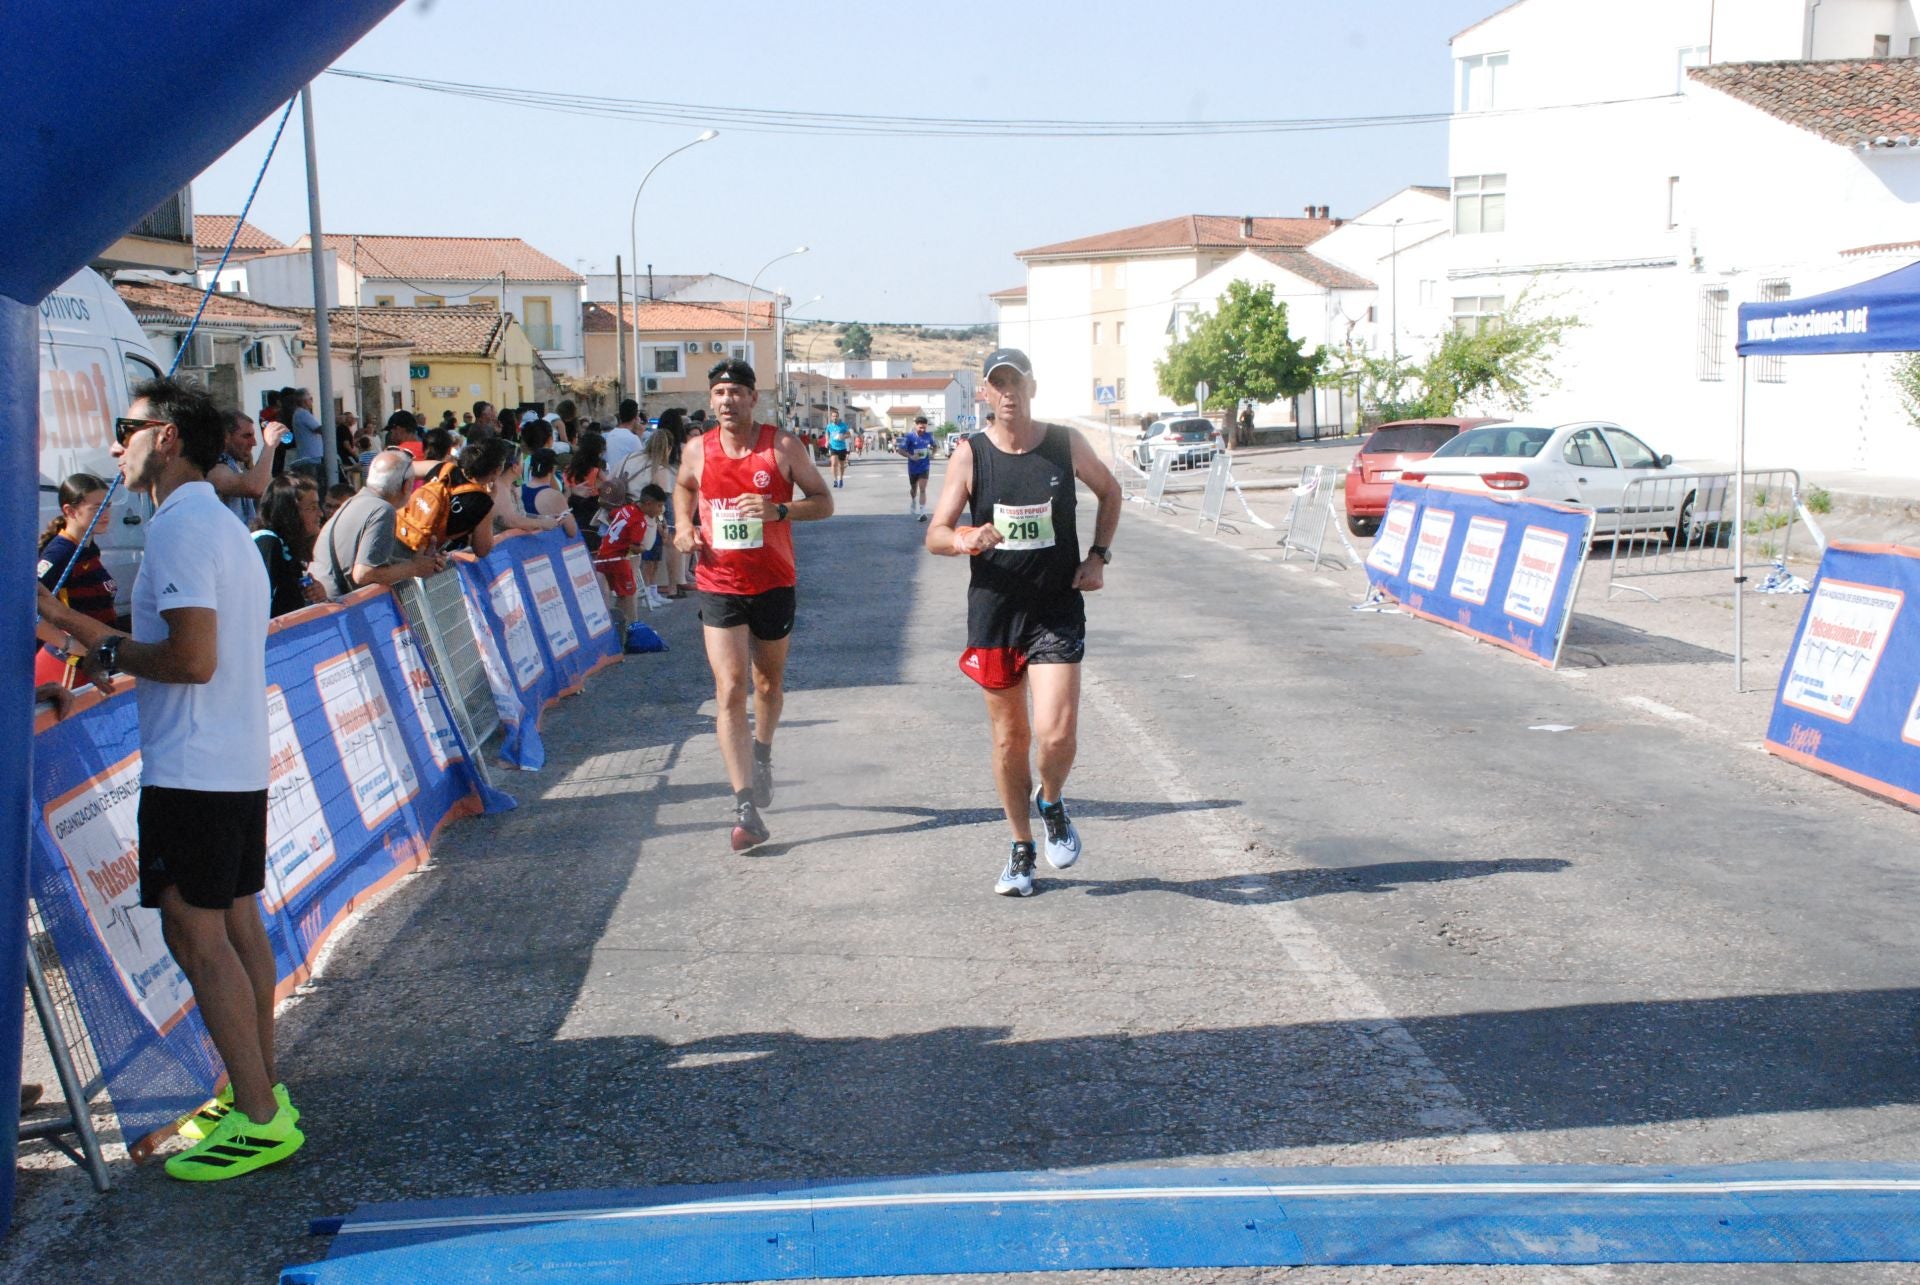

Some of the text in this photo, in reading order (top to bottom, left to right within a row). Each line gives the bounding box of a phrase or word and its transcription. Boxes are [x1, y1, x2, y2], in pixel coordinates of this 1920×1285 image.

[722, 524, 748, 540] 138
[1008, 521, 1039, 540] 219
[55, 800, 103, 840] ORGANIZACIÓN
[99, 790, 112, 811] DE
